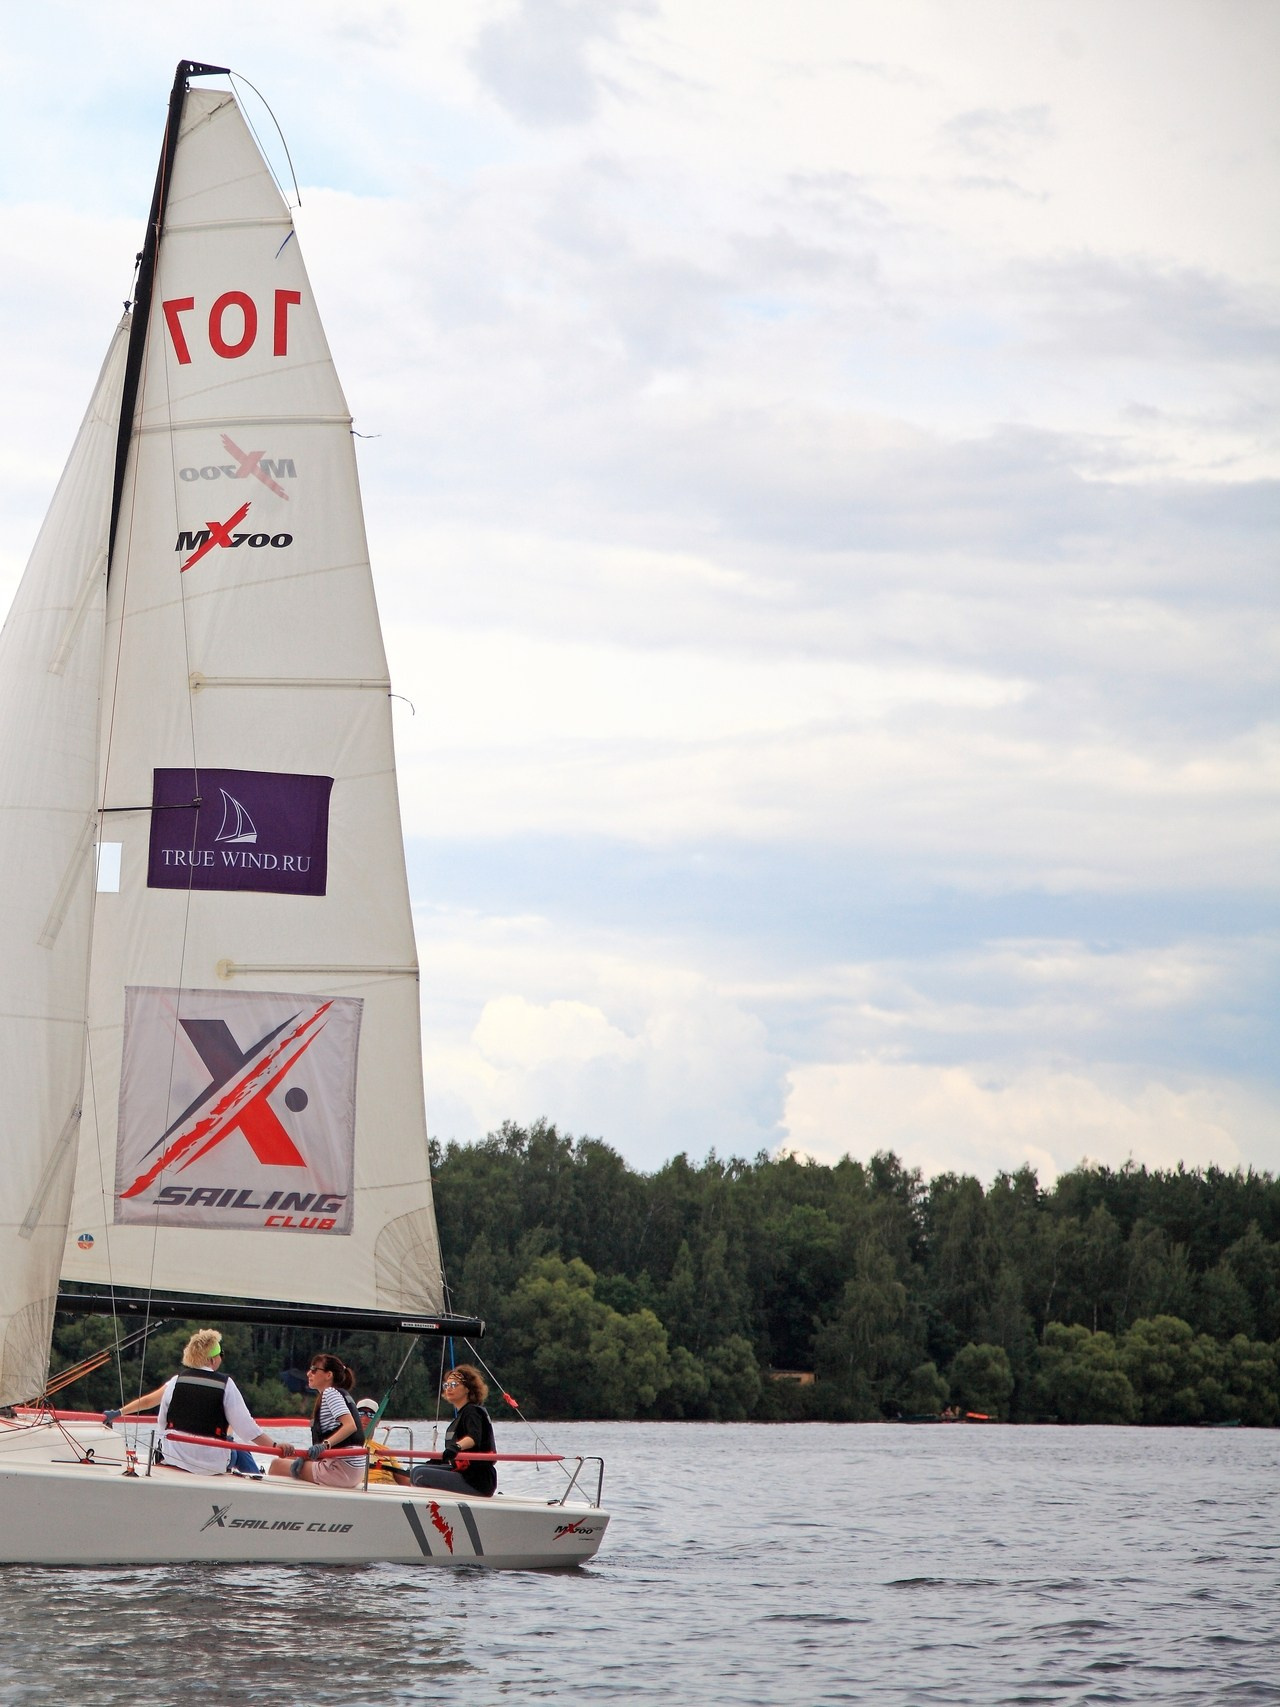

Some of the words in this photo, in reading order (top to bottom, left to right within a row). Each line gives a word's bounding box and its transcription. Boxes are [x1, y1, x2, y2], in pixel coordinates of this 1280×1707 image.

[175, 501, 294, 573] MX700
[162, 849, 215, 866] TRUE
[221, 851, 311, 872] WIND.RU
[152, 1186, 348, 1214] SAILING
[264, 1215, 337, 1230] CLUB
[228, 1518, 304, 1531] SAILING
[306, 1522, 353, 1533] CLUB
[552, 1517, 593, 1541] MX700
